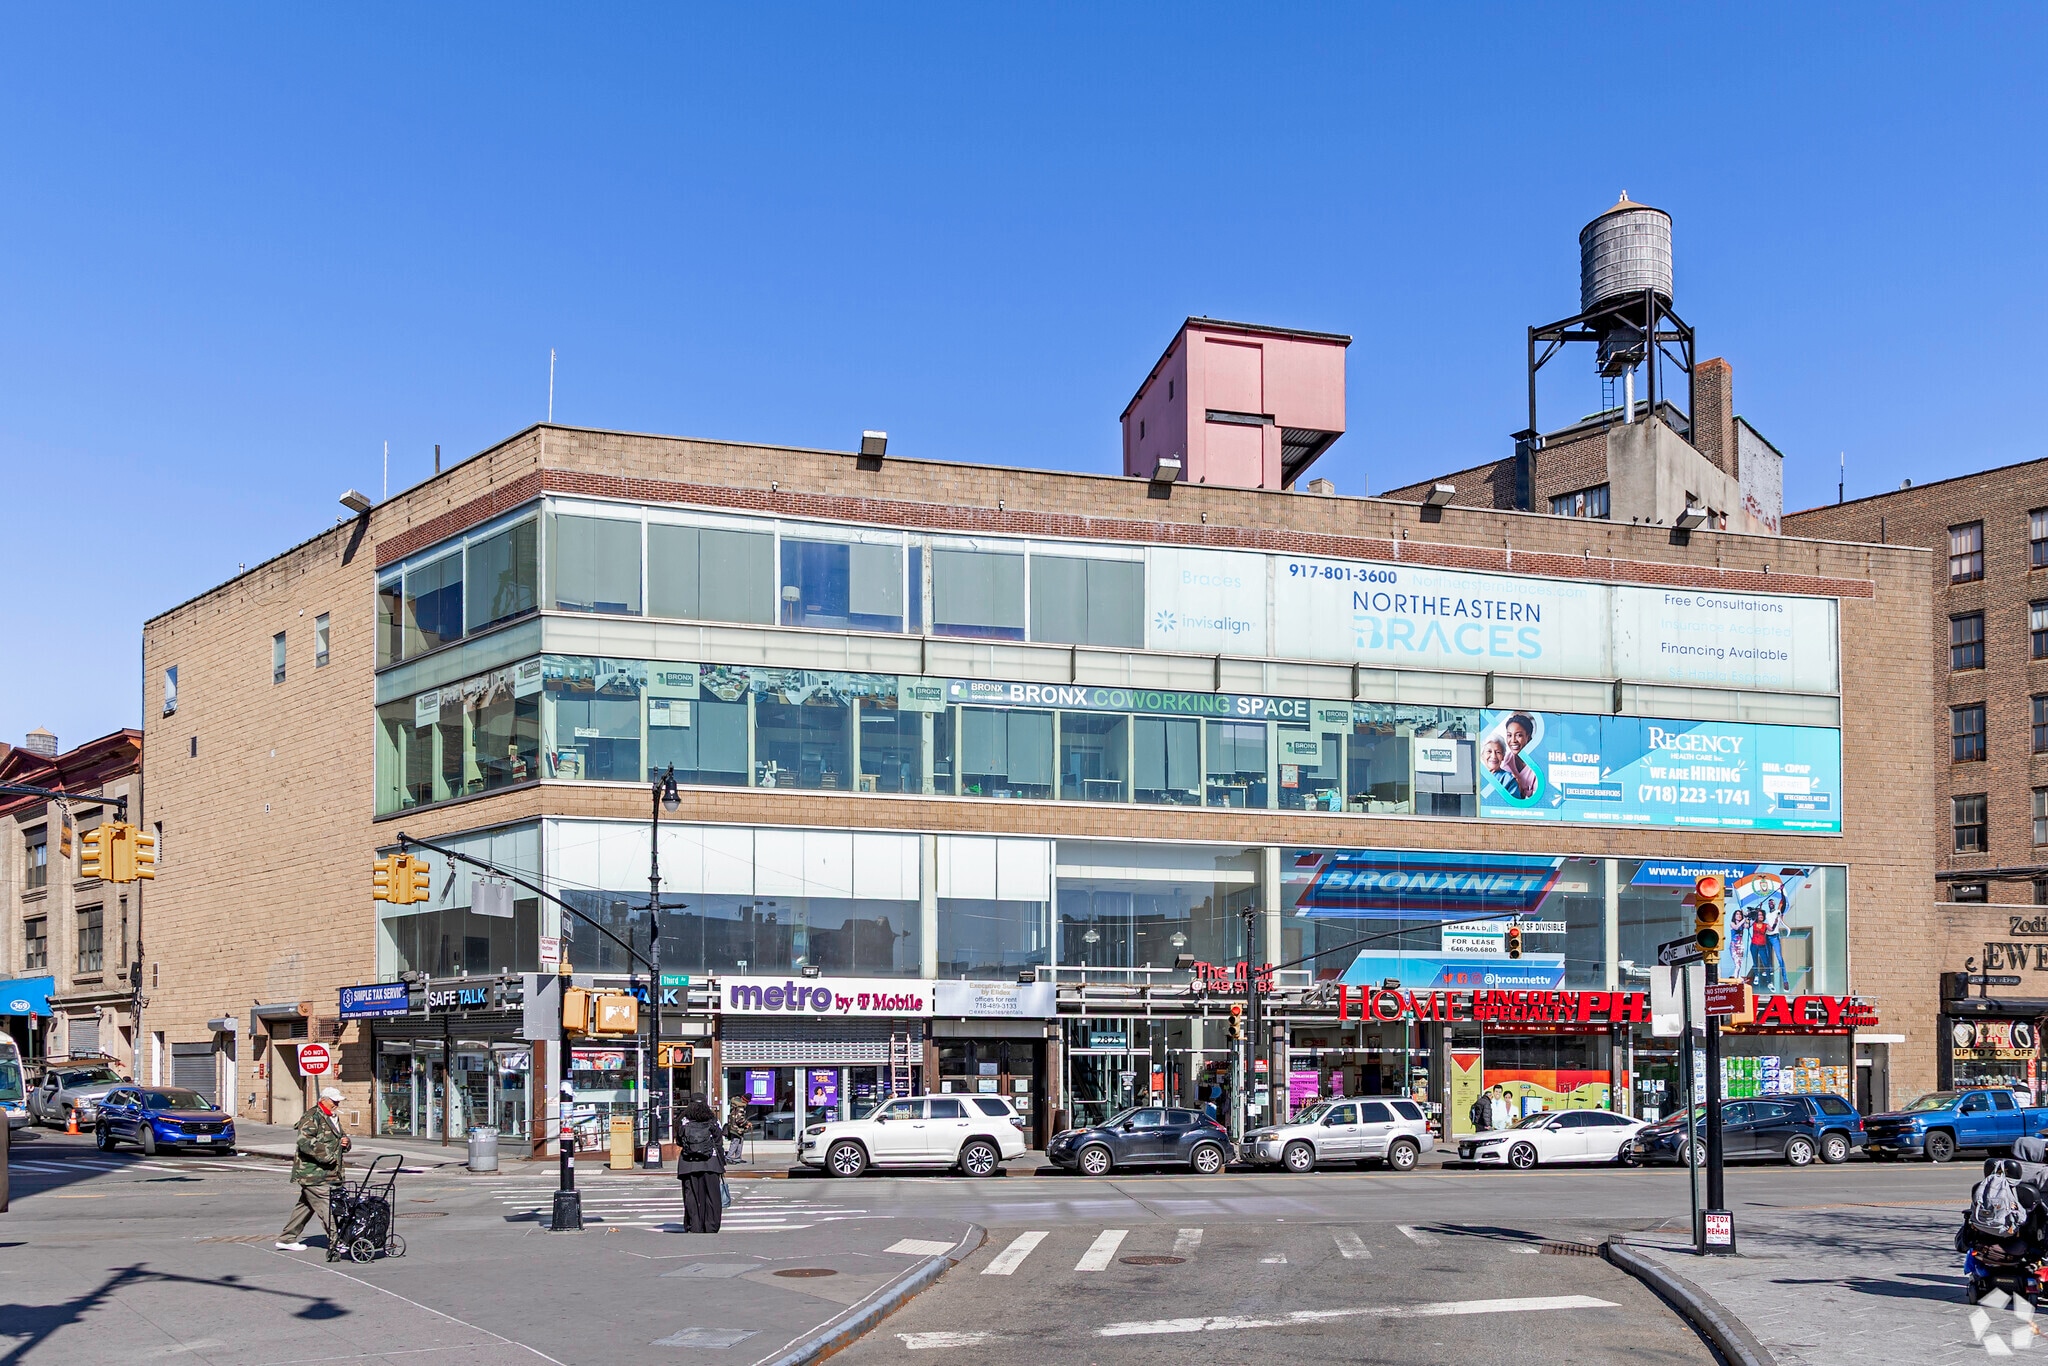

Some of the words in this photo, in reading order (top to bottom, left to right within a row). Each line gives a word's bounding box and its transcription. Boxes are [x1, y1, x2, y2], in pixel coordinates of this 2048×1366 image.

[1182, 569, 1242, 589] Braces
[1288, 563, 1398, 585] 917-801-3600
[1352, 590, 1541, 623] NORTHEASTERN
[1664, 593, 1692, 607] Free
[1696, 596, 1784, 613] Consultations
[1182, 613, 1251, 636] invisalign
[1660, 618, 1721, 634] Insurance
[1729, 622, 1792, 637] Accepted
[1350, 615, 1543, 659] BRACES
[1660, 642, 1725, 660] Financing
[1729, 646, 1788, 661] Available
[971, 683, 1004, 693] BRONX
[1010, 684, 1088, 706] BRONX
[1093, 690, 1231, 714] COWORKING
[1237, 697, 1307, 718] SPACE
[1648, 726, 1744, 754] REGENCY
[1548, 752, 1567, 763] HHA
[1572, 753, 1600, 764] CDPAP
[1670, 752, 1695, 761] HEALTH
[1695, 753, 1713, 762] CARE
[1650, 766, 1667, 779] WE
[1668, 767, 1690, 780] ARE
[1690, 765, 1741, 783] HIRING
[1762, 762, 1780, 773] HHA
[1784, 763, 1811, 774] CDPAP
[1566, 788, 1595, 797] EXCELENTES
[1595, 790, 1621, 798] BENEFICIOS
[1638, 784, 1678, 805] (718)
[1679, 787, 1707, 804] 223
[1648, 865, 1745, 878] www.bronxnet.tv
[1322, 869, 1543, 896] BRONXNET
[1526, 922, 1534, 931] SF
[1535, 922, 1565, 932] DIVISIBLE
[1471, 938, 1496, 946] LEASE
[1663, 948, 1678, 961] ONE
[1194, 962, 1228, 979] The
[663, 975, 679, 985] Third
[1484, 973, 1551, 985] @bronxnettv
[354, 989, 372, 1001] SIMPLE
[372, 988, 383, 1000] TAX
[383, 986, 406, 999] SERVICE
[429, 990, 456, 1006] SAFE
[459, 988, 487, 1004] TALK
[624, 988, 678, 1004] TAK
[731, 981, 832, 1011] metro
[1473, 990, 1576, 1005] LINCOLN
[1714, 986, 1737, 994] STOPPING
[835, 993, 854, 1014] by
[872, 993, 923, 1011] Mobile
[1337, 984, 1464, 1021] HOME
[1577, 991, 1853, 1025] PHACY
[1849, 1005, 1874, 1014] DEPT
[1473, 1005, 1576, 1021] SPECIALTY
[1843, 1016, 1879, 1026] WITHIN
[1977, 1023, 2009, 1038] BIG
[1097, 1036, 1121, 1045] 2825
[1955, 1049, 1969, 1057] UP
[1973, 1049, 1985, 1057] TO
[1989, 1049, 2010, 1057] 70%
[2014, 1049, 2033, 1057] OFF
